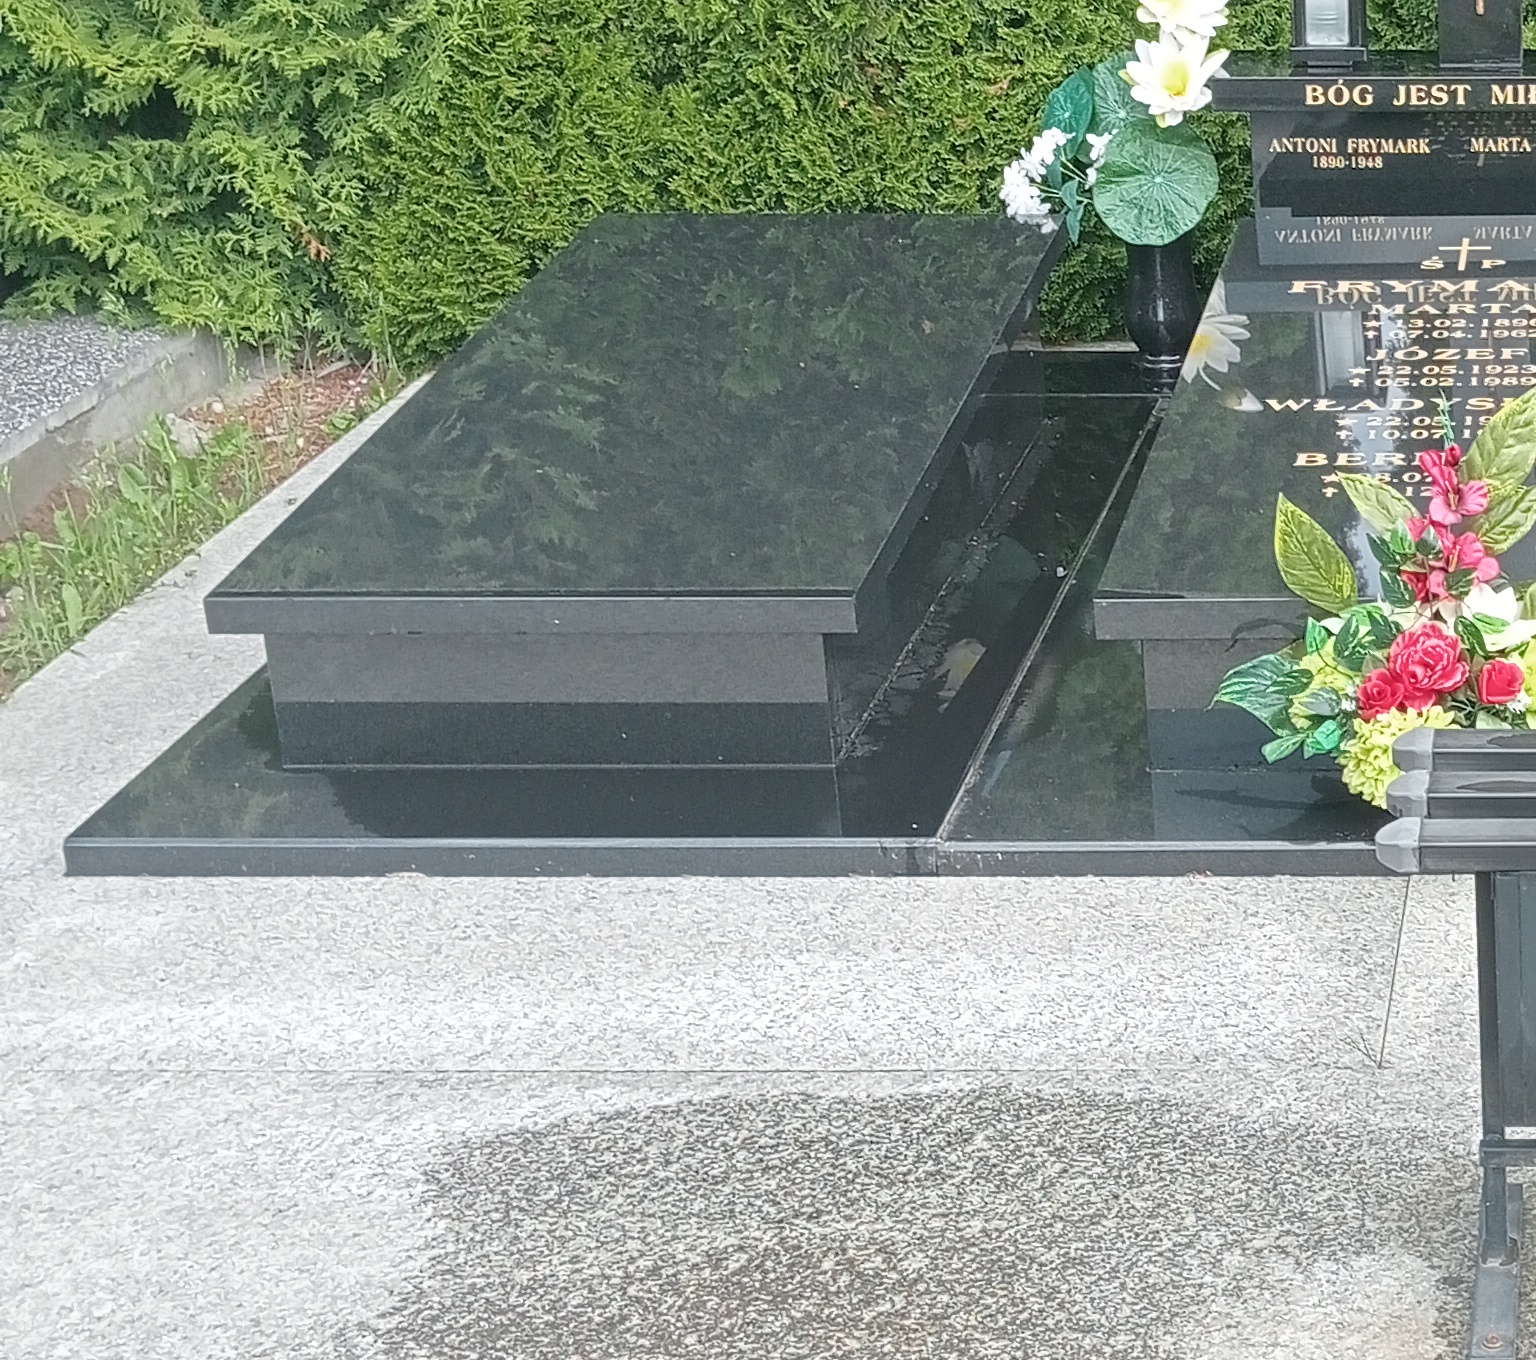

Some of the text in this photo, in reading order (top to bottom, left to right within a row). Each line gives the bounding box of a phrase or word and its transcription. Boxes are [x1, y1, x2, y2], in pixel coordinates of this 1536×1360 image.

[1305, 78, 1375, 106] BÓG
[1392, 84, 1472, 106] JEST
[1268, 138, 1431, 154] ANTONI FRYMARK
[1470, 137, 1532, 152] MARTA
[1420, 256, 1507, 270] Ś P
[1366, 346, 1530, 361] JÓZEF
[1366, 416, 1496, 427] 22.05.19
